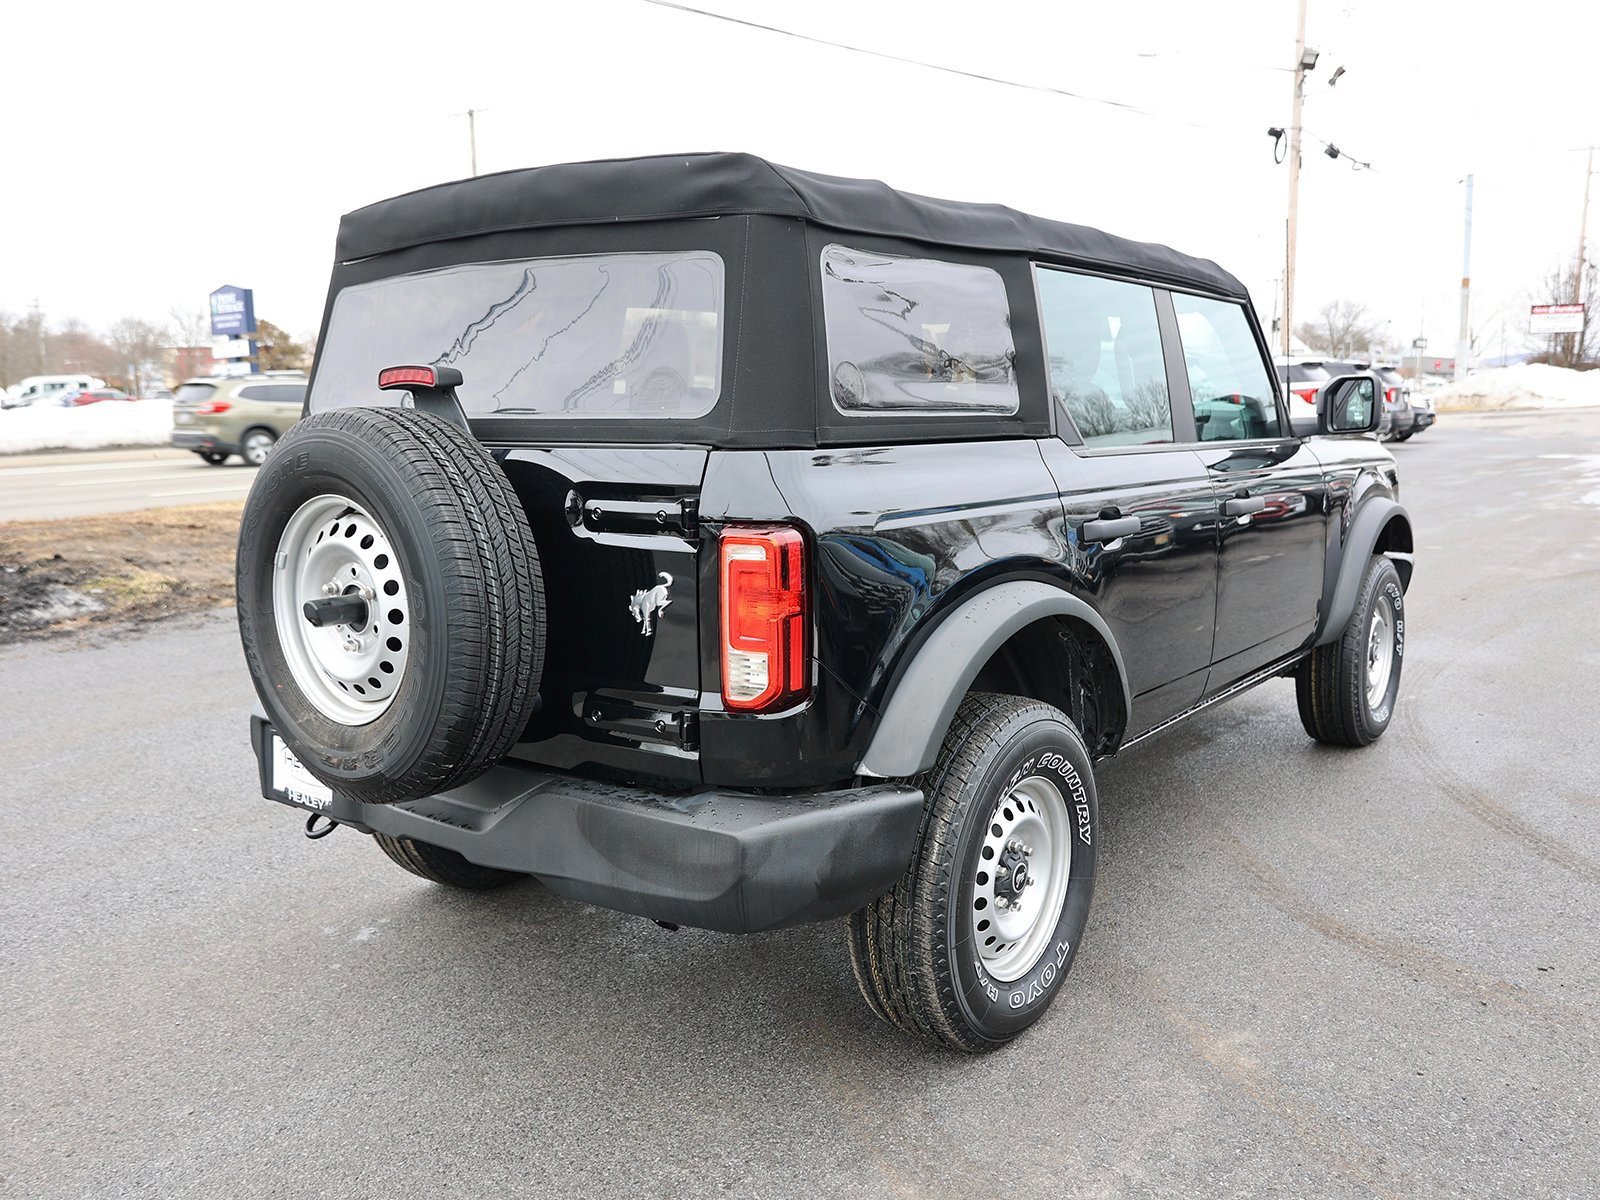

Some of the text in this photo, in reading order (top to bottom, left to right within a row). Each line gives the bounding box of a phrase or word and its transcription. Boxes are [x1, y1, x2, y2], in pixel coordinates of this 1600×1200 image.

[287, 790, 324, 810] HEALEY
[1036, 752, 1092, 846] COUNTRY
[1008, 941, 1071, 1009] TOYO
